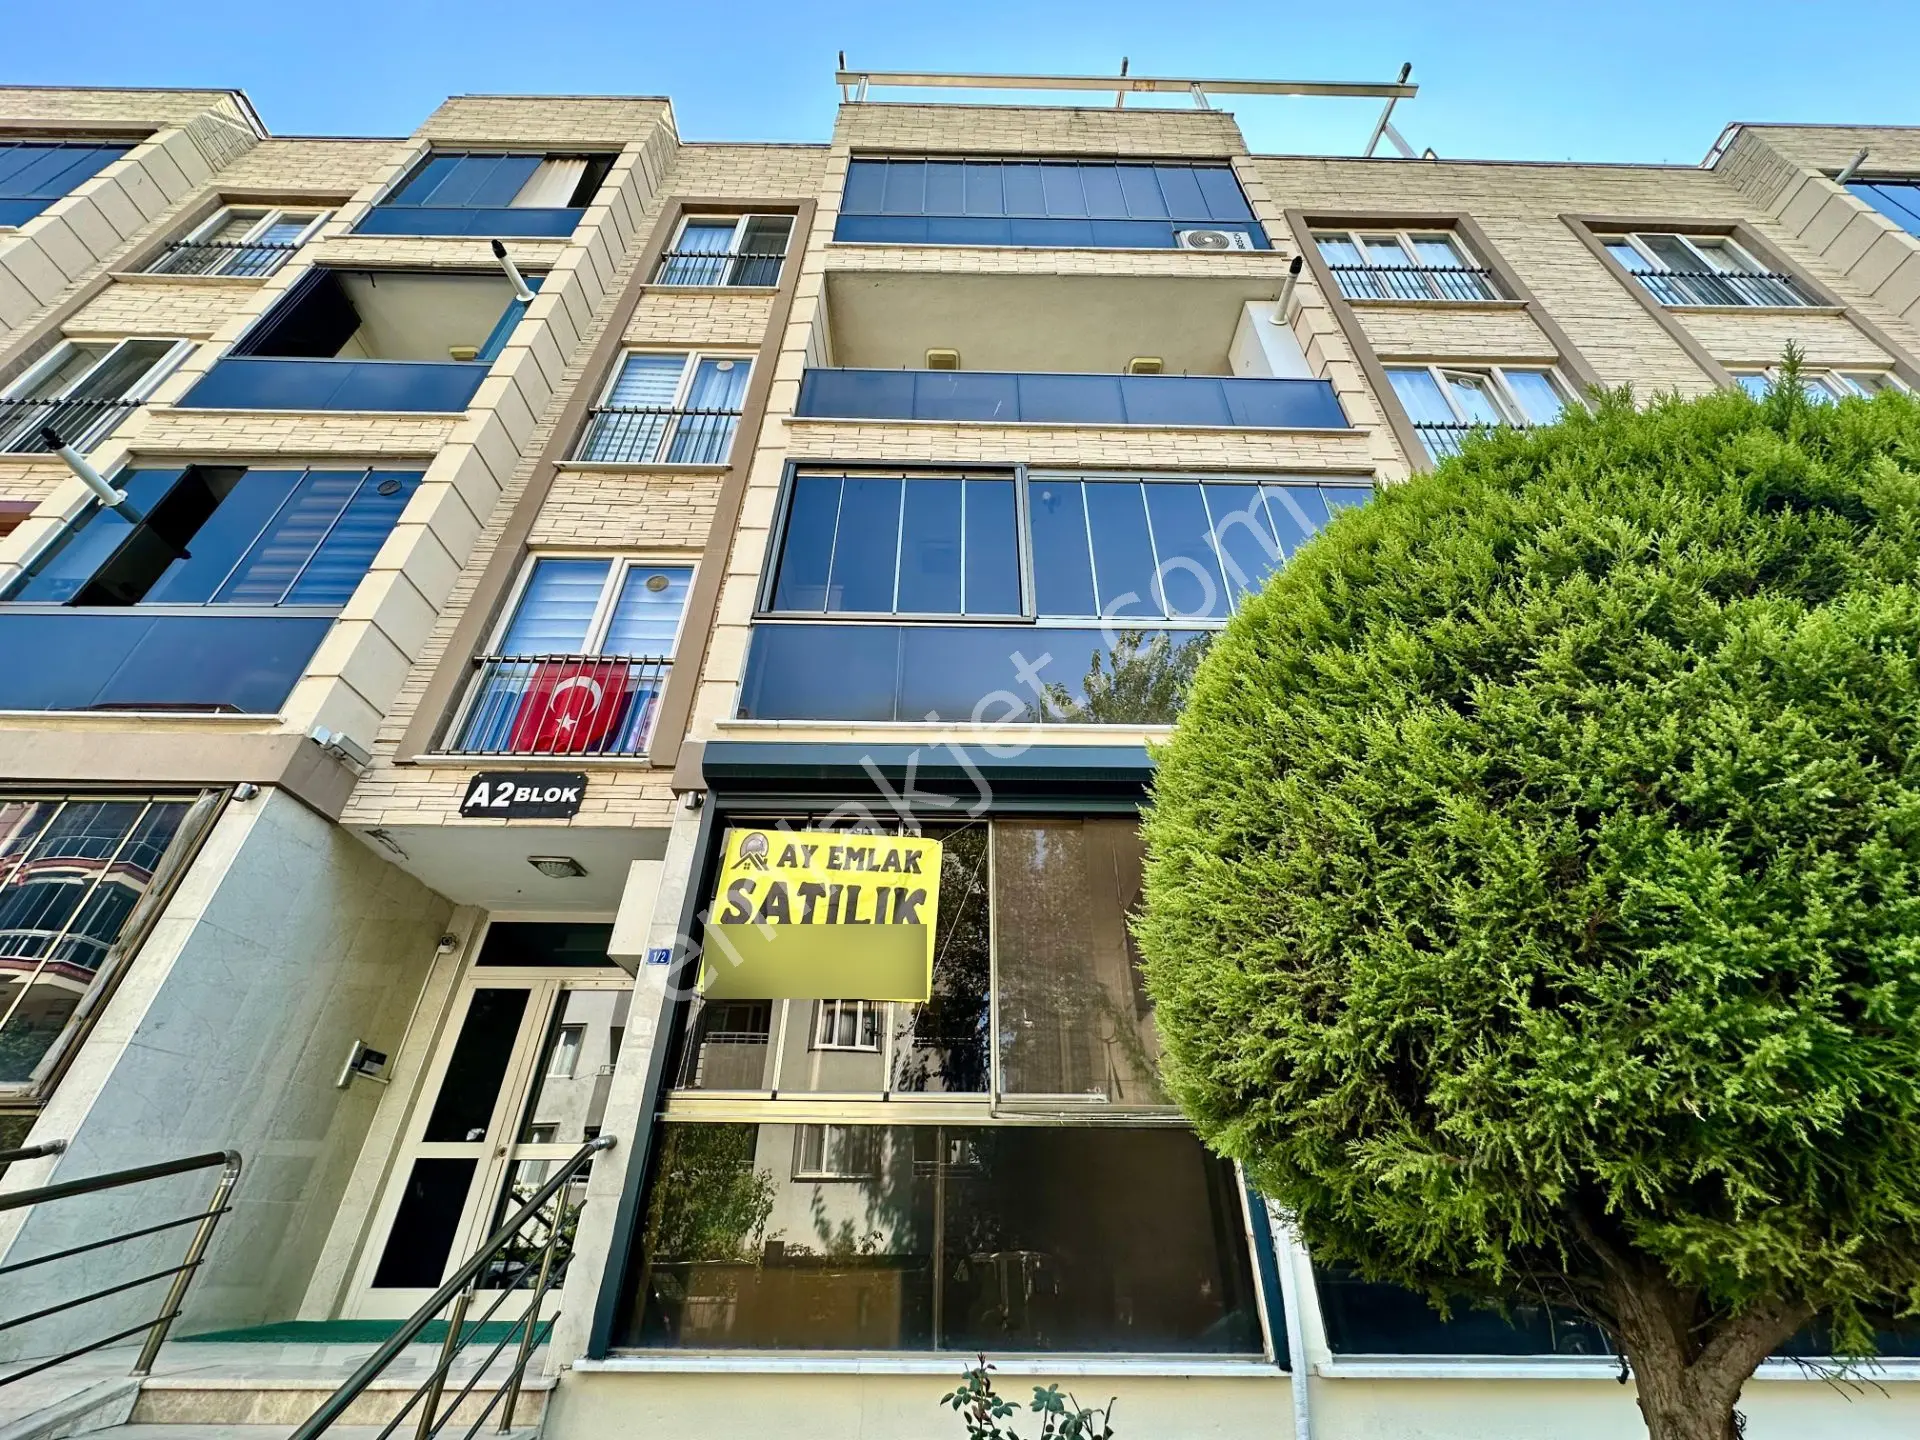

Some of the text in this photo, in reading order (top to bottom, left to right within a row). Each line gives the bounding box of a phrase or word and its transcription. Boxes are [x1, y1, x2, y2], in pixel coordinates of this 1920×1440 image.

[464, 781, 581, 807] A2 BLOK
[776, 843, 922, 874] AY EMLAK
[720, 878, 928, 924] SATILIK
[652, 950, 667, 962] 1/2
